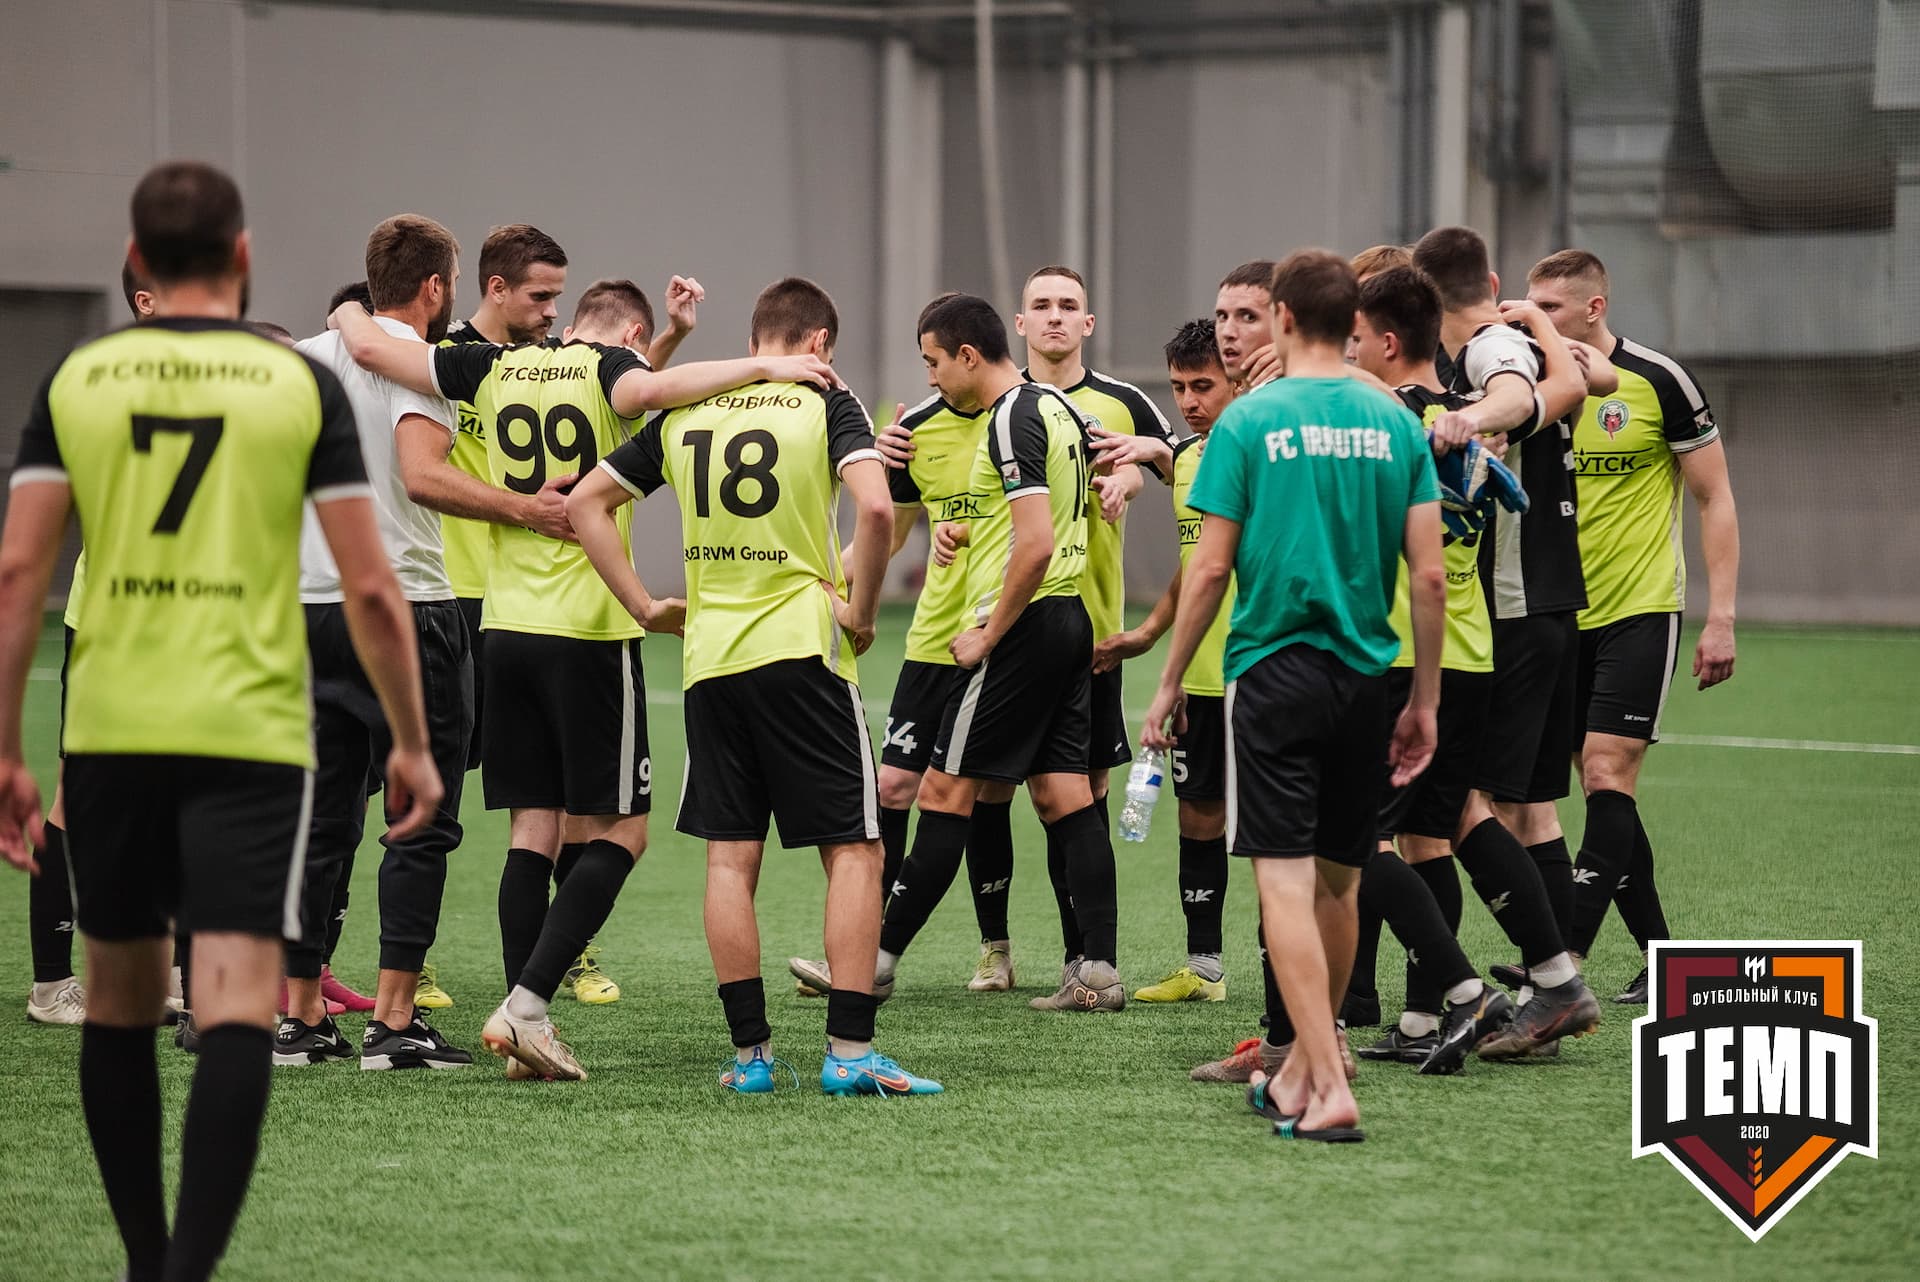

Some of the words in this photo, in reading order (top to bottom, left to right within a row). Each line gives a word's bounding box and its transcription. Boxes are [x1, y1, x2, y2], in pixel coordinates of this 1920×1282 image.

[497, 403, 598, 496] 99
[1264, 428, 1298, 463] FC
[131, 413, 225, 535] 7
[682, 429, 780, 518] 18
[702, 546, 736, 561] RVM
[740, 546, 788, 564] Group
[124, 578, 176, 598] RVM
[638, 757, 652, 796] 9
[1172, 750, 1189, 783] 5
[1183, 889, 1215, 903] 2K
